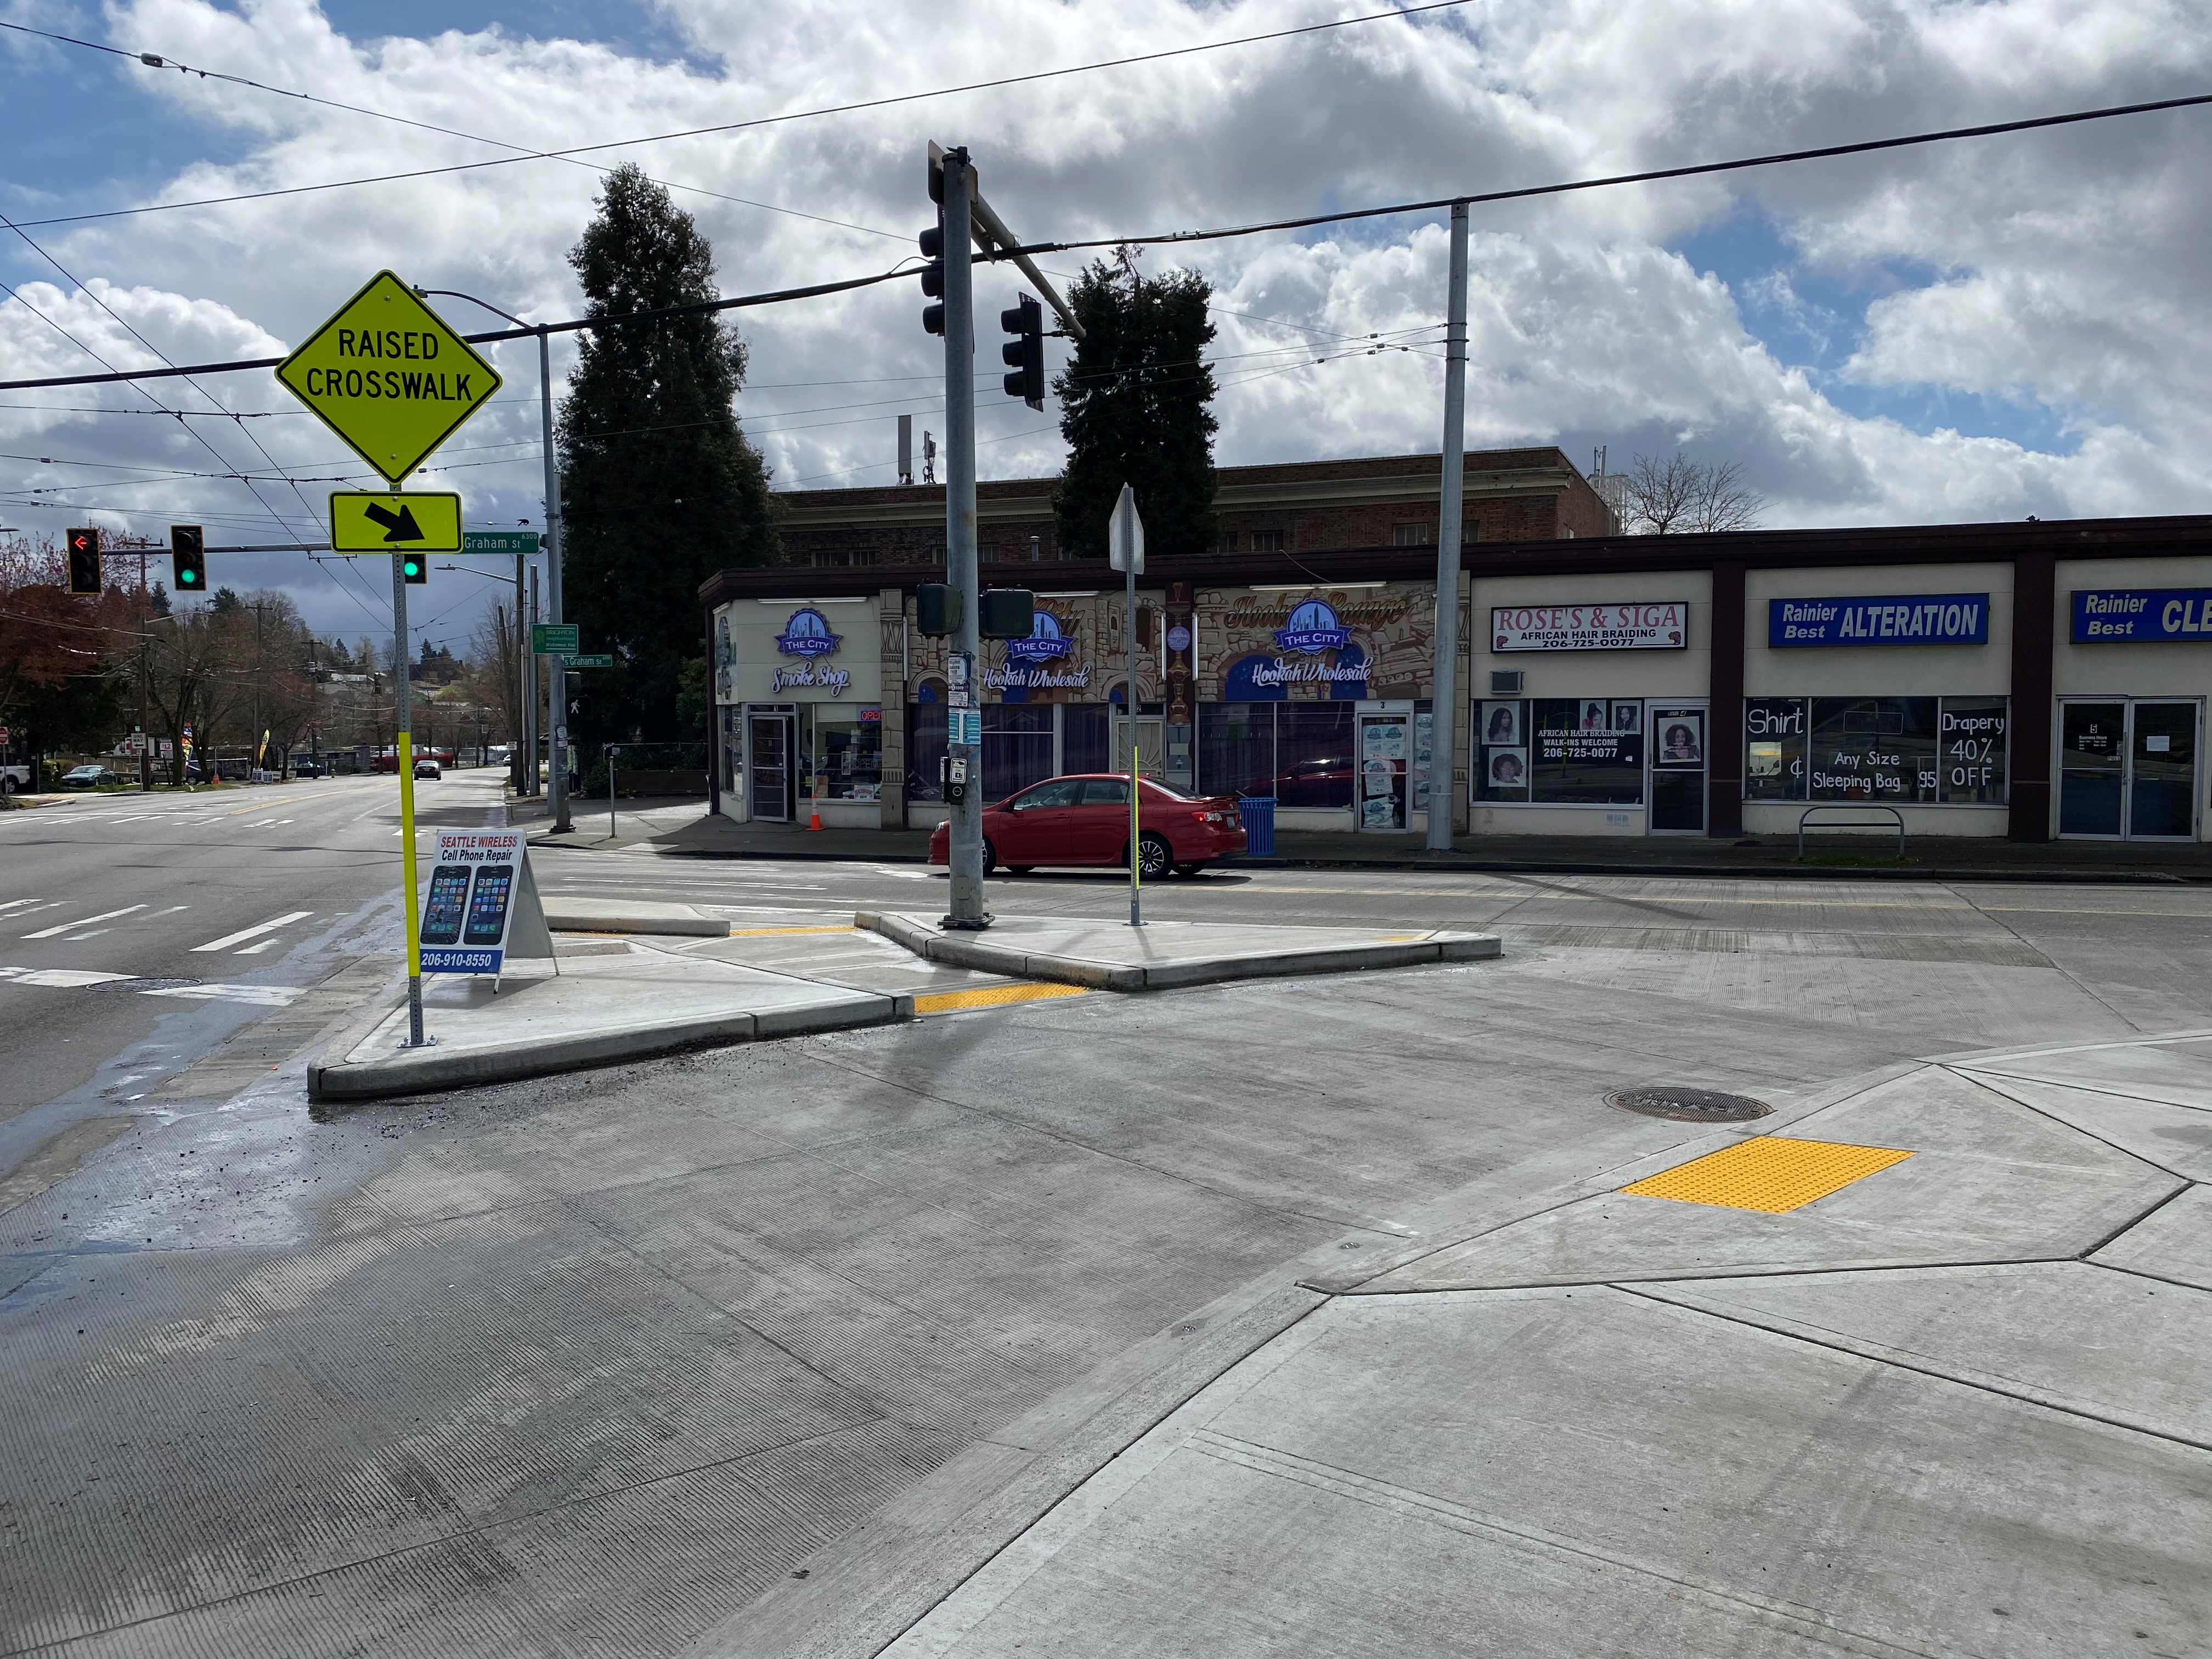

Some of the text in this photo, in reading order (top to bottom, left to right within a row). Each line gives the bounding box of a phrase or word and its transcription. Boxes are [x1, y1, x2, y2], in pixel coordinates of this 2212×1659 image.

[338, 329, 438, 360] RAISED
[307, 368, 473, 402] CROSSWALK
[464, 537, 507, 549] Graham
[1223, 591, 1312, 629] Hook
[1782, 603, 1837, 622] Rainier
[2086, 594, 2148, 614] Rainier
[1497, 605, 1680, 631] ROSE'S & SIGA
[1838, 604, 1978, 638] ALTERATION
[1520, 629, 1657, 641] AFRICAN HAIR BRAIDING
[1784, 624, 1826, 639] Best
[2087, 620, 2135, 635] Best
[785, 640, 805, 650] THE
[1014, 642, 1036, 652] THE
[1284, 634, 1310, 645] THE
[1542, 638, 1635, 648] 206-725-0077
[569, 657, 594, 665] Graham
[771, 661, 850, 697] Smoke Shop
[983, 663, 1091, 691] Hookah Wholesale
[1251, 656, 1373, 687] Hookah Wholesale
[1747, 707, 1803, 735] Shirt
[1942, 713, 2005, 735] Drapery
[2091, 724, 2096, 733] 5
[1543, 748, 1618, 758] 206-725-0077
[1834, 751, 1900, 769] Any Size
[1949, 737, 1993, 765] 40%
[854, 759, 878, 769] OPEN
[1812, 771, 1901, 793] Sleeping Bag
[1951, 766, 1993, 787] OFF
[441, 836, 518, 848] SEATTLE WIRELESS
[442, 849, 514, 864] Cell Phone Repair
[420, 953, 492, 967] 206-910-8550
